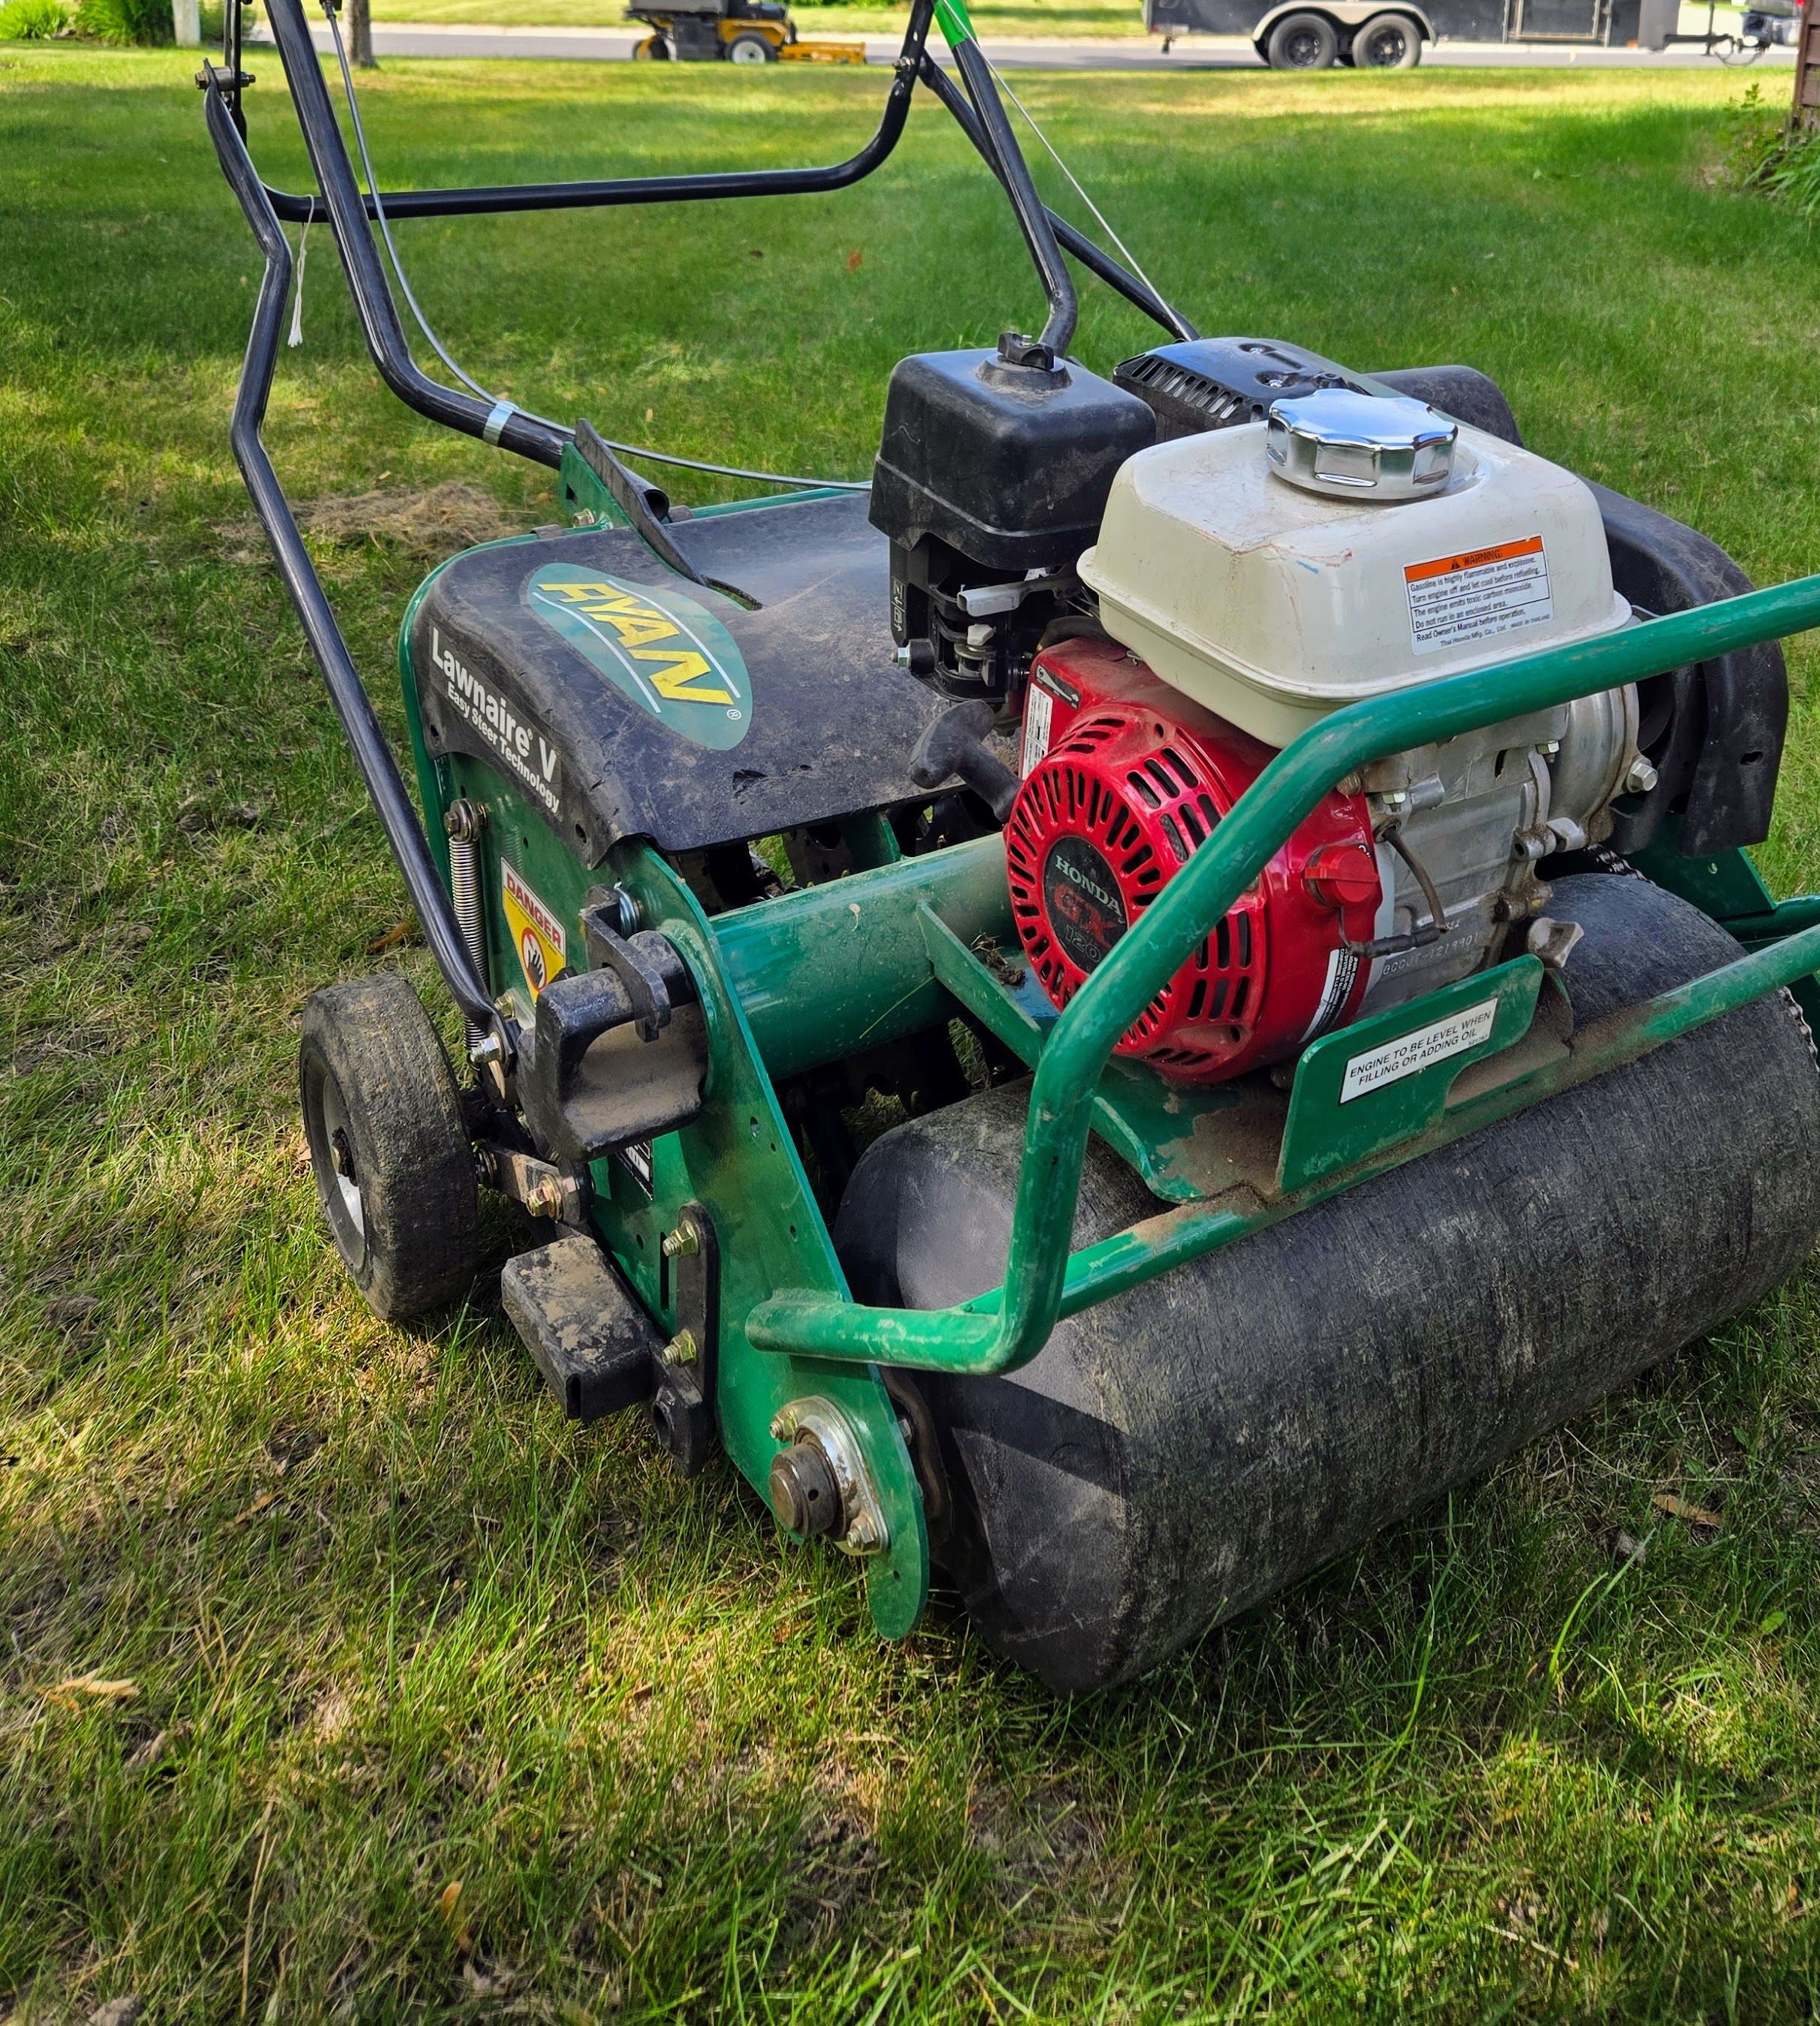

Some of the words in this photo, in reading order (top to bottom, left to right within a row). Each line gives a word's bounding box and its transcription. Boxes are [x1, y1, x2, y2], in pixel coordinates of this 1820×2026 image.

[1411, 579, 1436, 592] Gasoline
[1444, 572, 1462, 584] highly
[1464, 565, 1495, 578] flammable
[1496, 562, 1507, 571] and
[1463, 549, 1502, 566] WARNING
[1412, 595, 1426, 604] Turn
[1428, 589, 1448, 601] engine
[1459, 583, 1471, 592] and
[1482, 578, 1493, 587] cool
[1494, 572, 1513, 584] before
[1414, 608, 1426, 617] The
[1428, 602, 1447, 614] engine
[1450, 598, 1465, 608] emits
[1467, 595, 1481, 605] toxic
[1483, 589, 1503, 599] carbon
[1416, 620, 1424, 630] Do
[1426, 617, 1436, 626] not
[1438, 615, 1447, 624] run
[1465, 602, 1491, 616] enclosed
[1417, 631, 1432, 643] Read
[1433, 627, 1456, 638] Owner's
[1457, 618, 1477, 631] Manual
[1480, 615, 1498, 626] before
[538, 583, 735, 705] RYAN
[448, 682, 470, 718] Easy
[472, 708, 498, 745] Steer
[500, 735, 560, 813] Technology
[539, 737, 557, 782] V
[1055, 855, 1122, 916] HONDA
[507, 873, 561, 950] DANGER
[1055, 883, 1117, 950] GX
[1065, 925, 1101, 963] 120
[1351, 1053, 1390, 1078] ENGINE
[1393, 1046, 1407, 1059] TO
[1410, 1040, 1423, 1052] BE
[1427, 1025, 1458, 1045] LEVEL
[1461, 1011, 1491, 1030] WHEN
[1359, 1061, 1399, 1085] FILLING
[1402, 1053, 1417, 1067] OR
[1420, 1036, 1459, 1060] ADDING
[1461, 1029, 1477, 1041] OIL
